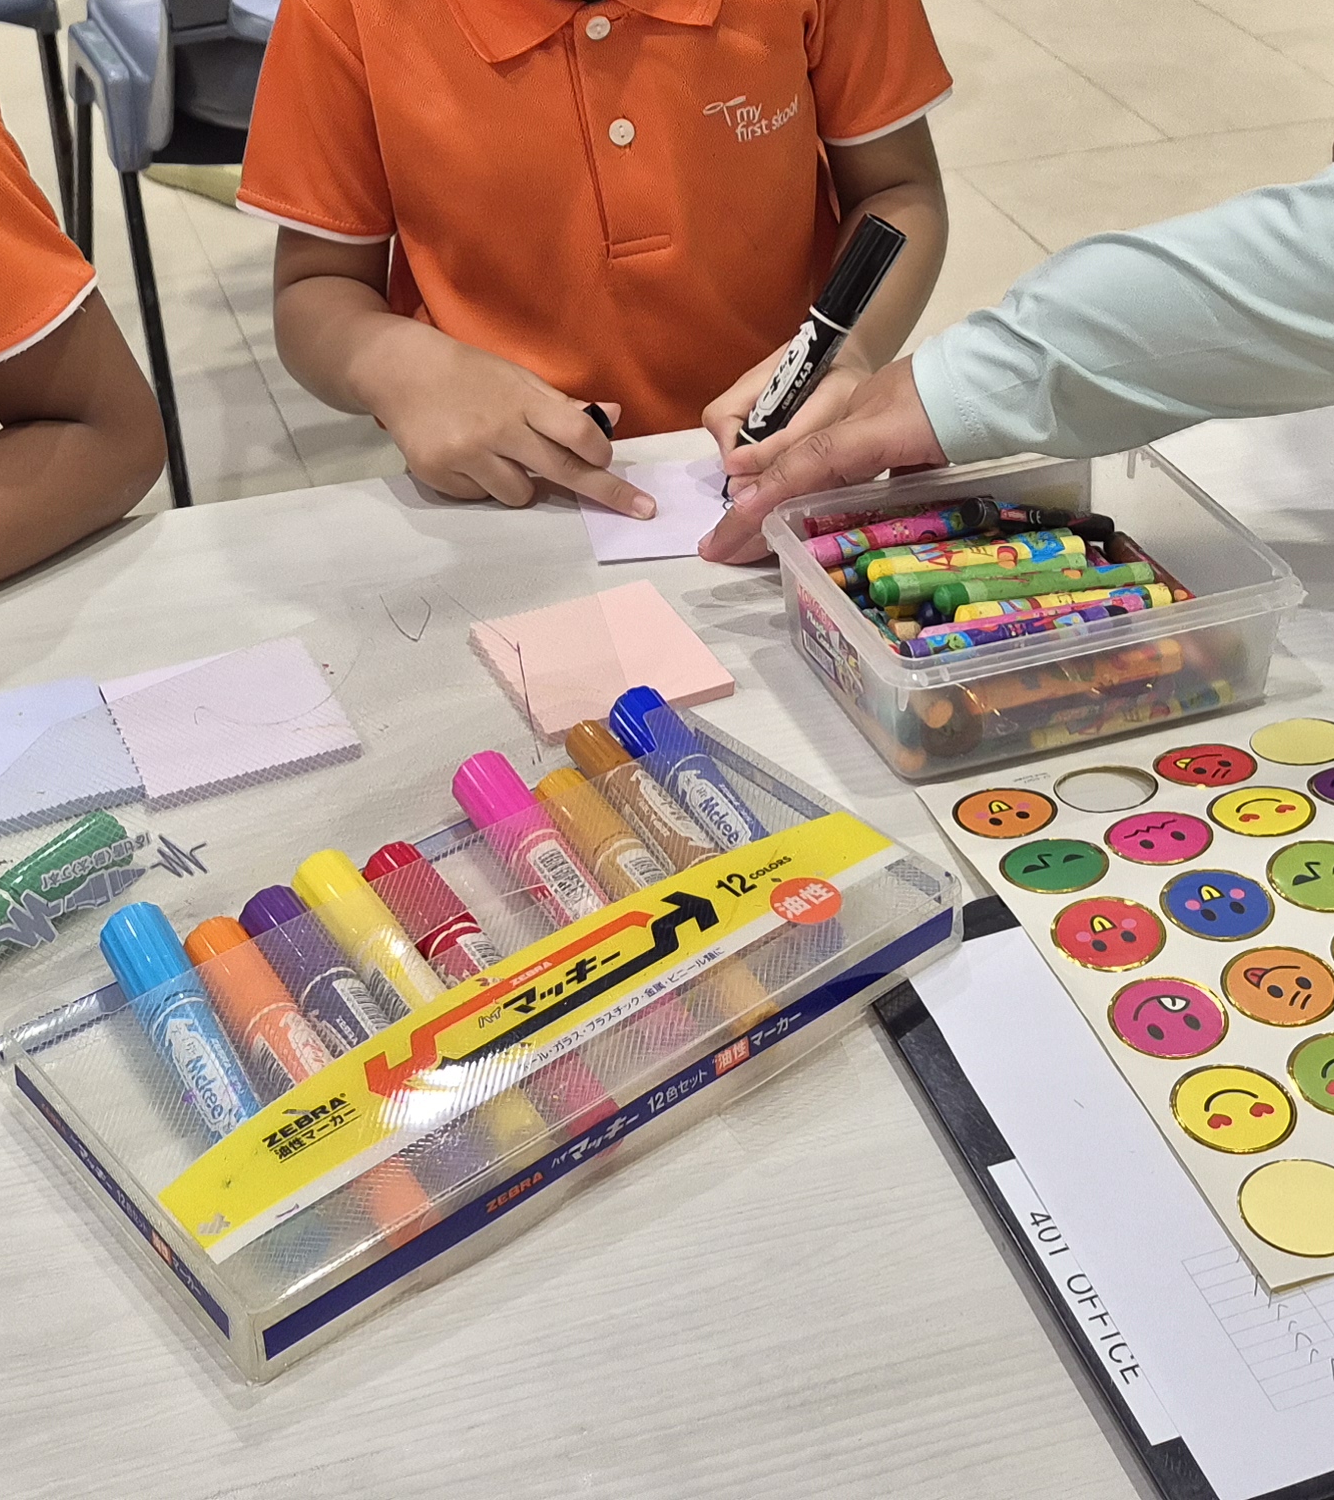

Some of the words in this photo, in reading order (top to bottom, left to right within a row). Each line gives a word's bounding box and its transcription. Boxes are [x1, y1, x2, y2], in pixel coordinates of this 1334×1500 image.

[736, 103, 762, 123] my
[736, 119, 769, 142] first
[772, 94, 799, 131] skool
[715, 872, 757, 898] 12
[749, 855, 792, 881] COLORS
[773, 882, 836, 921] 油性
[509, 961, 553, 988] ZEBRA
[647, 1068, 708, 1113] 12色セット
[751, 1011, 802, 1046] マーカー
[262, 1093, 343, 1148] ZEBRA
[273, 1107, 357, 1161] 油性マーカー
[486, 1171, 544, 1213] ZEBRA
[1029, 1210, 1070, 1257] 401
[1067, 1272, 1140, 1385] OFFICE
